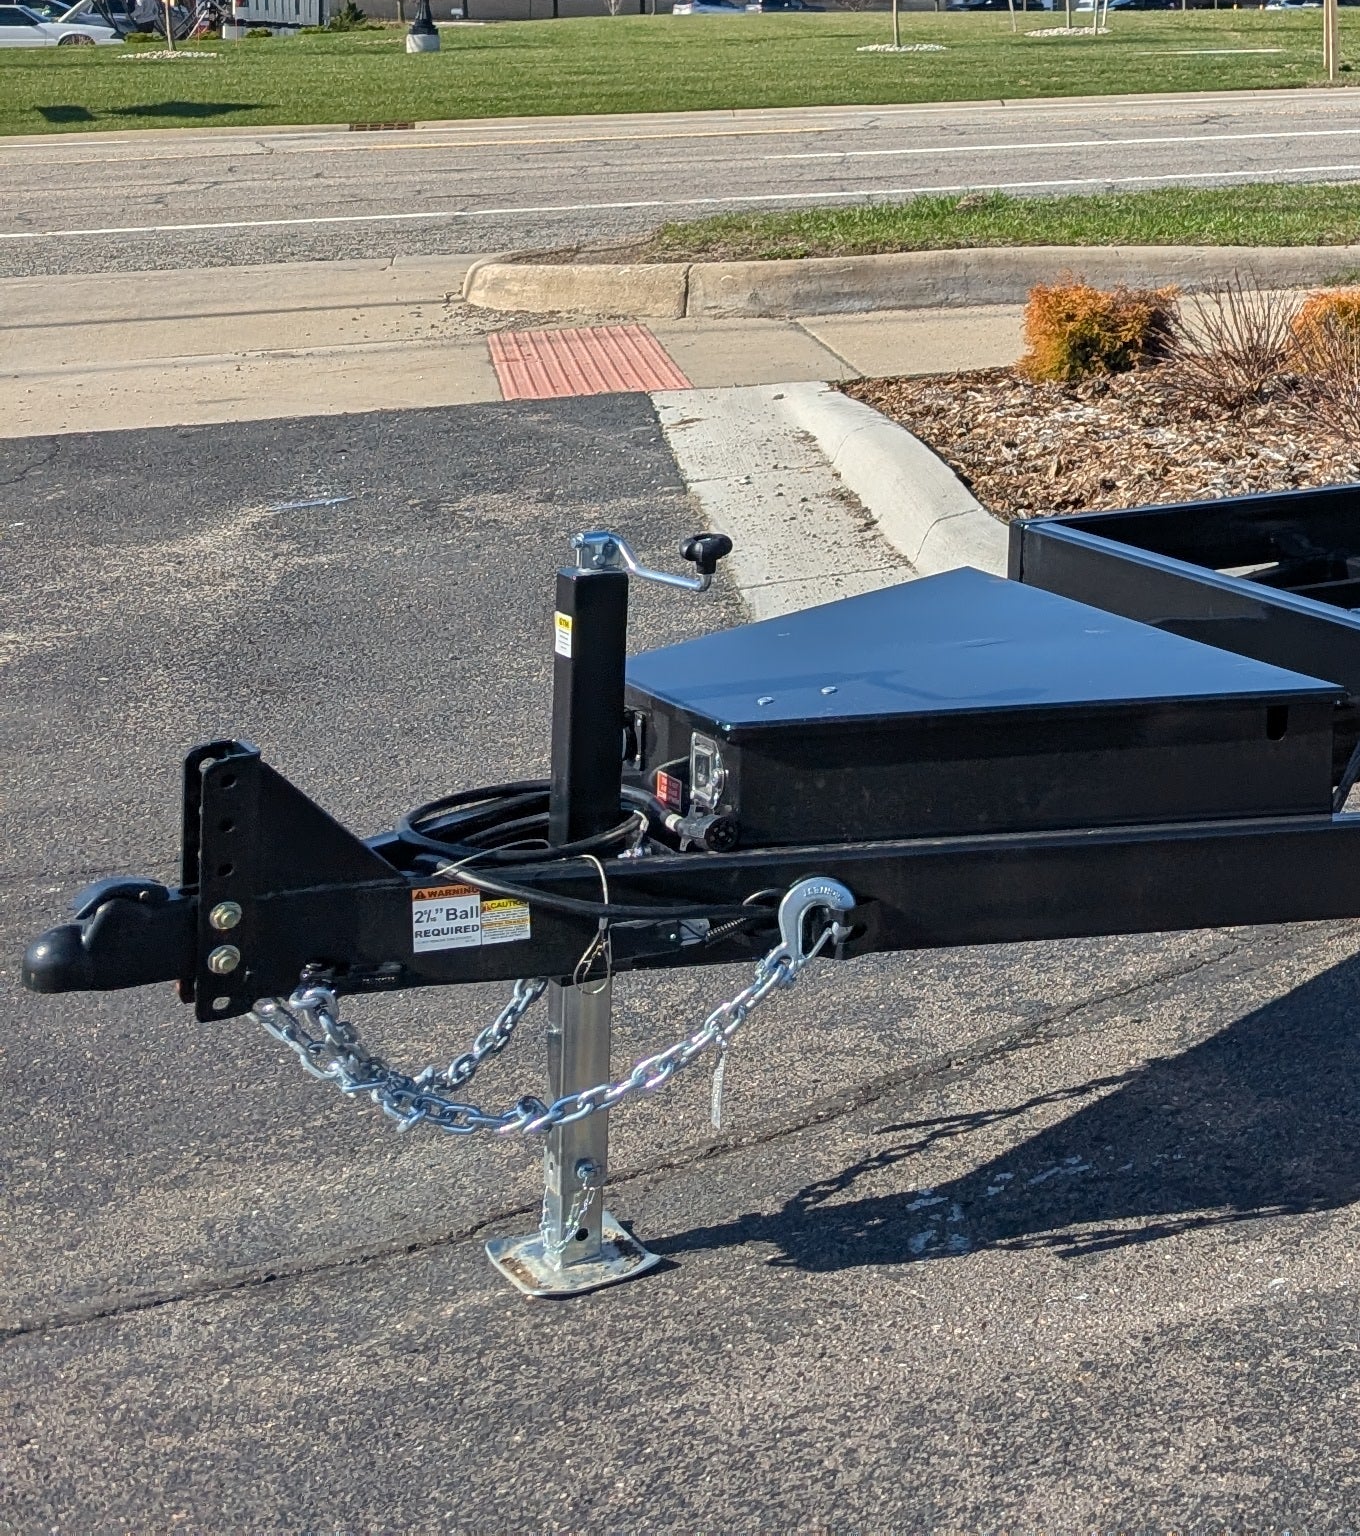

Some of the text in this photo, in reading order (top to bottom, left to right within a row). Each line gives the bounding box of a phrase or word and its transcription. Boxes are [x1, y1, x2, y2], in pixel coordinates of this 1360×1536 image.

[428, 886, 480, 899] WARNING
[445, 906, 479, 922] Ball
[414, 924, 480, 939] REQUIRED
